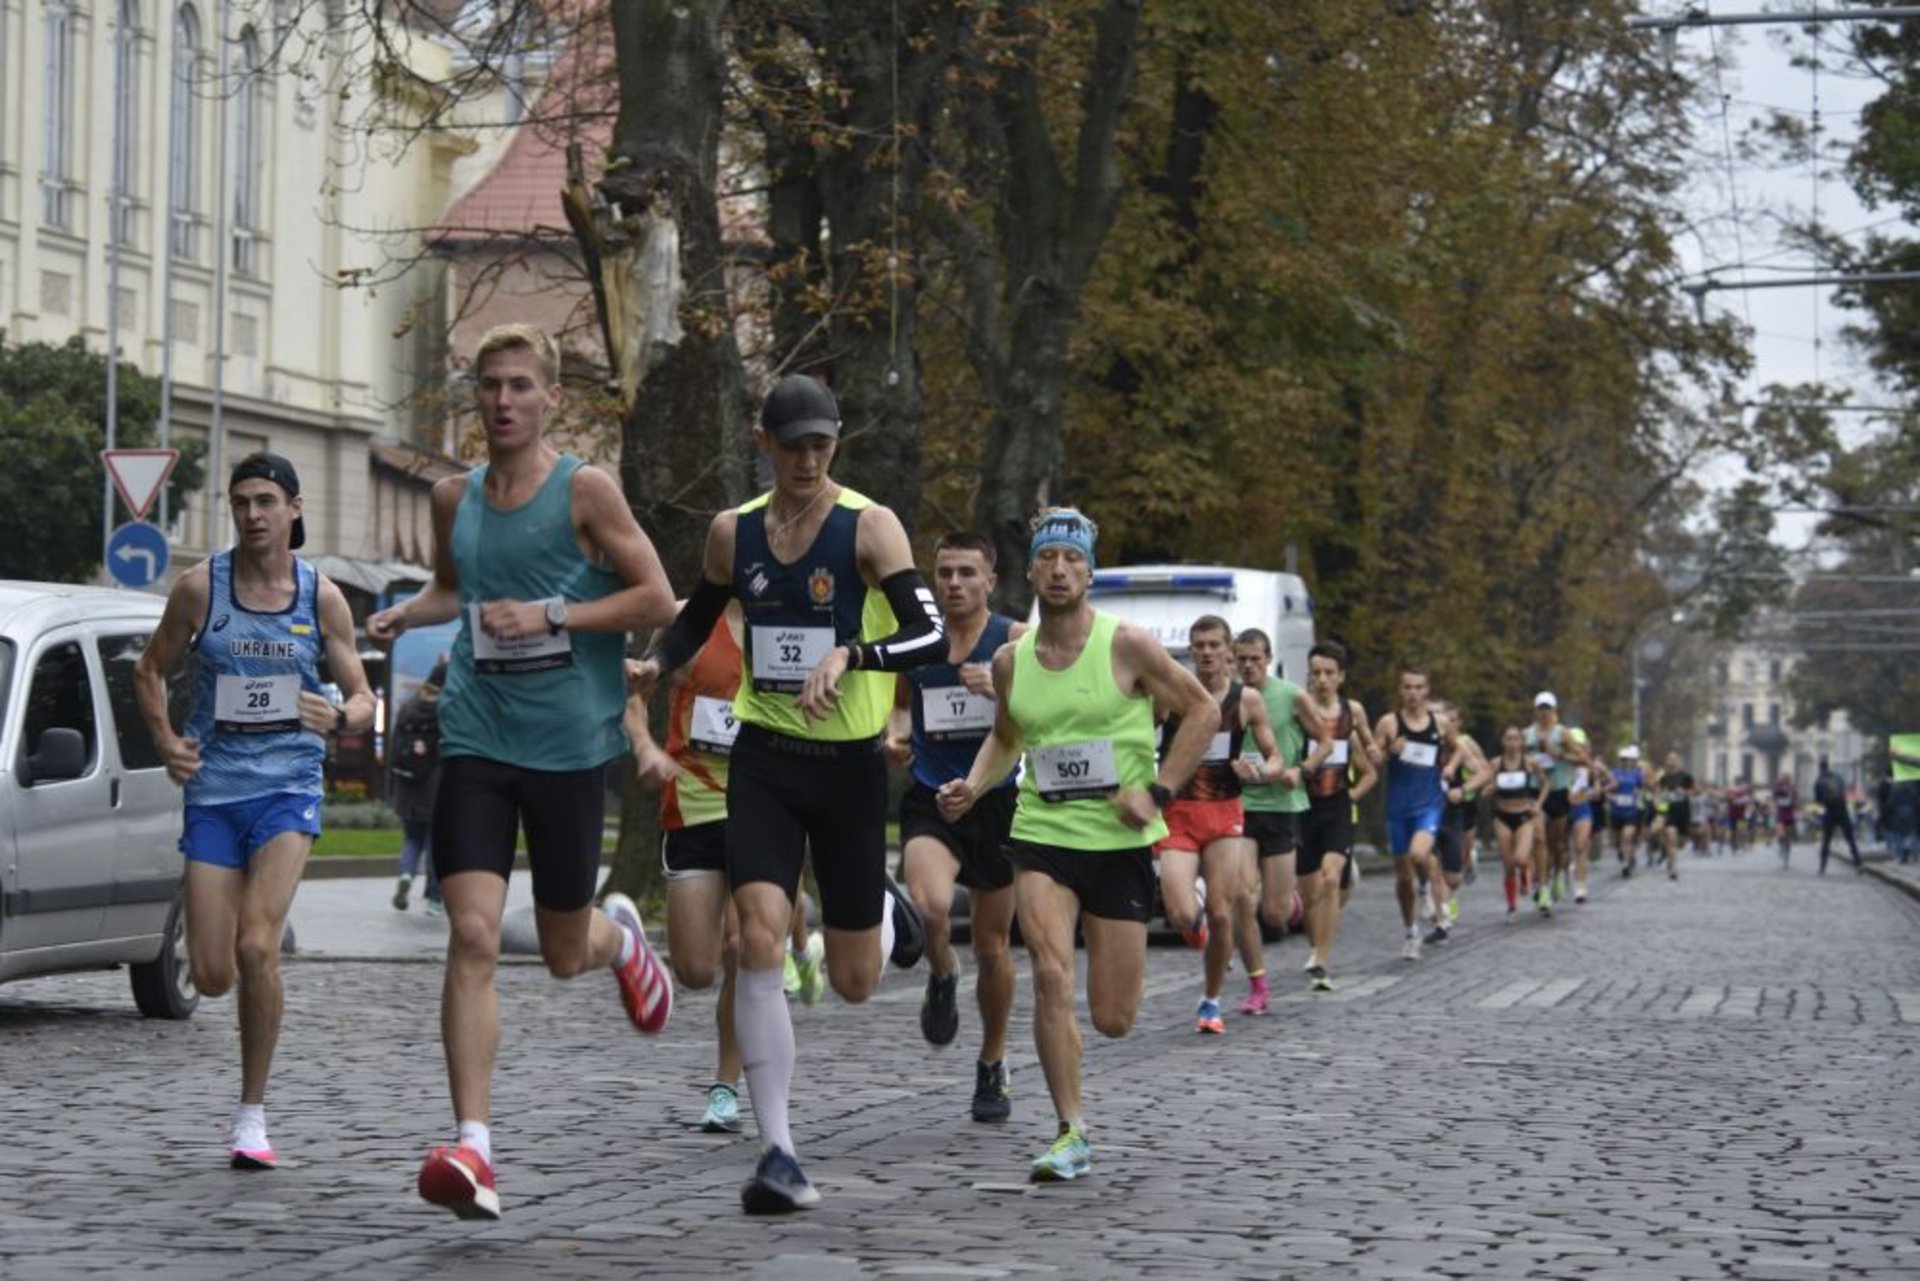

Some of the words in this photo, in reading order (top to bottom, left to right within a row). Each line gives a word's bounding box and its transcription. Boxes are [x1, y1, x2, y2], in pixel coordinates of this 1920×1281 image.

[231, 641, 295, 658] UKRAINE
[780, 644, 802, 662] 32
[247, 692, 270, 708] 28
[951, 701, 966, 716] 17
[724, 716, 735, 730] 9
[1057, 759, 1090, 778] 507
